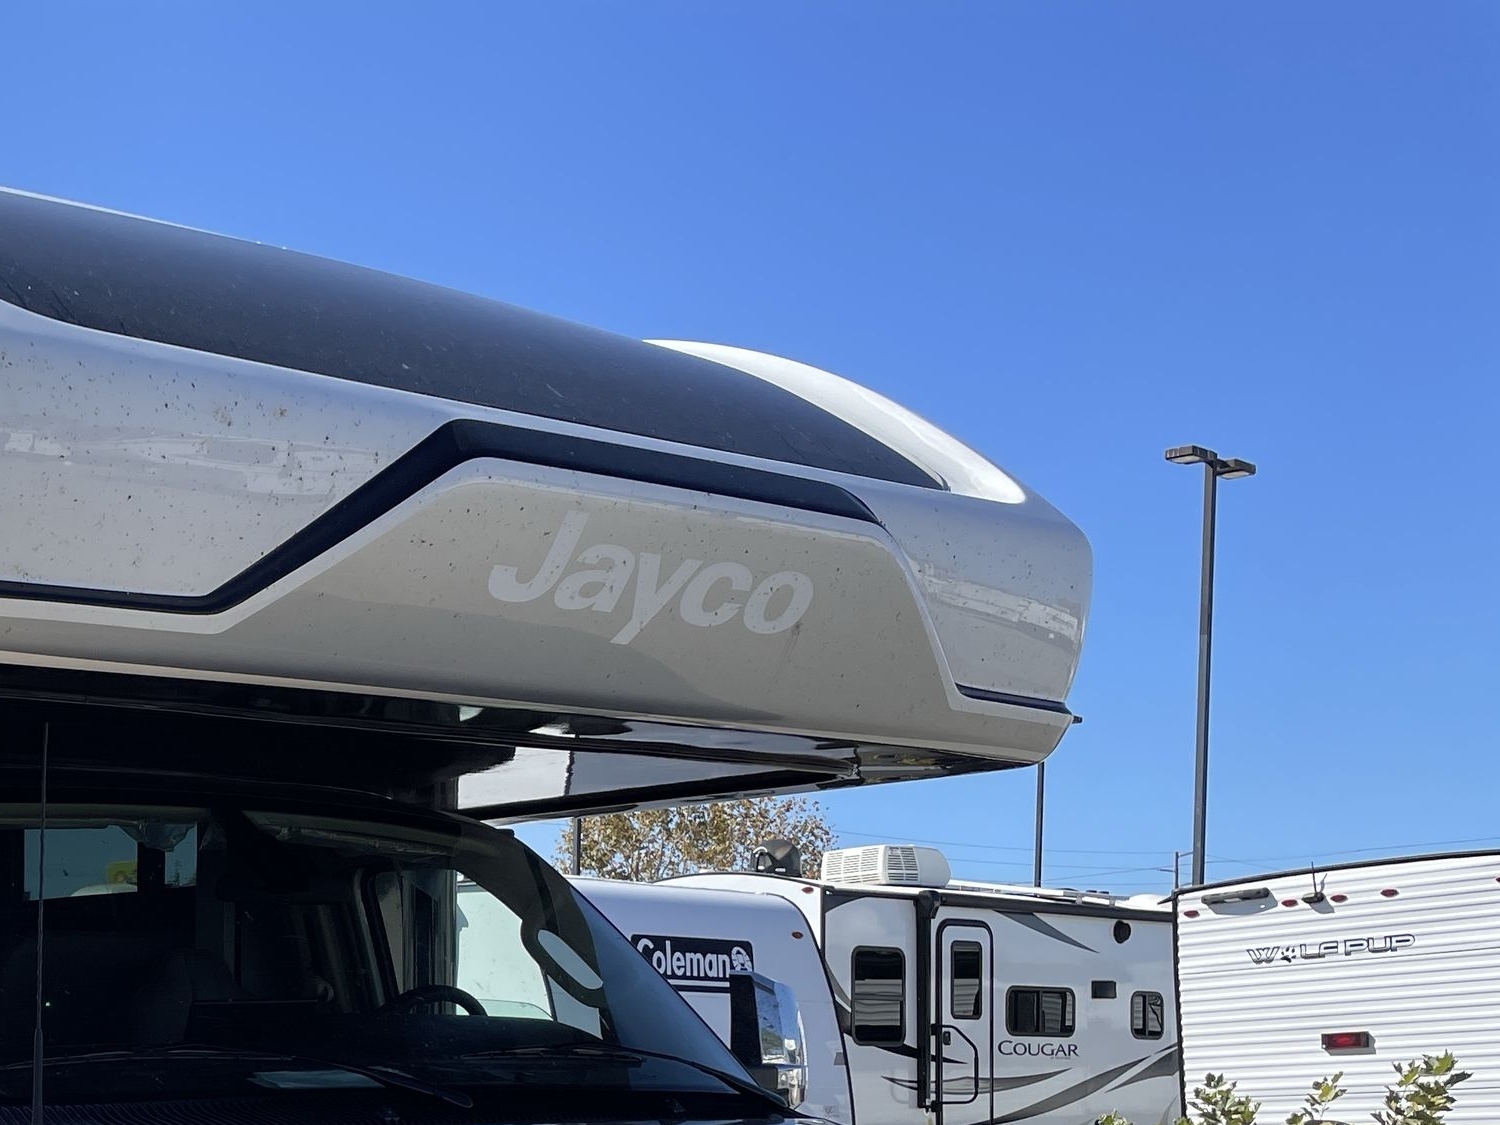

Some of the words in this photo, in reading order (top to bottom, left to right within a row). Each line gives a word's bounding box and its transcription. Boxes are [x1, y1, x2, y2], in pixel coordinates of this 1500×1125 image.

[488, 510, 814, 645] Jayco
[1344, 934, 1415, 956] PUP
[998, 1040, 1079, 1057] COUGAR
